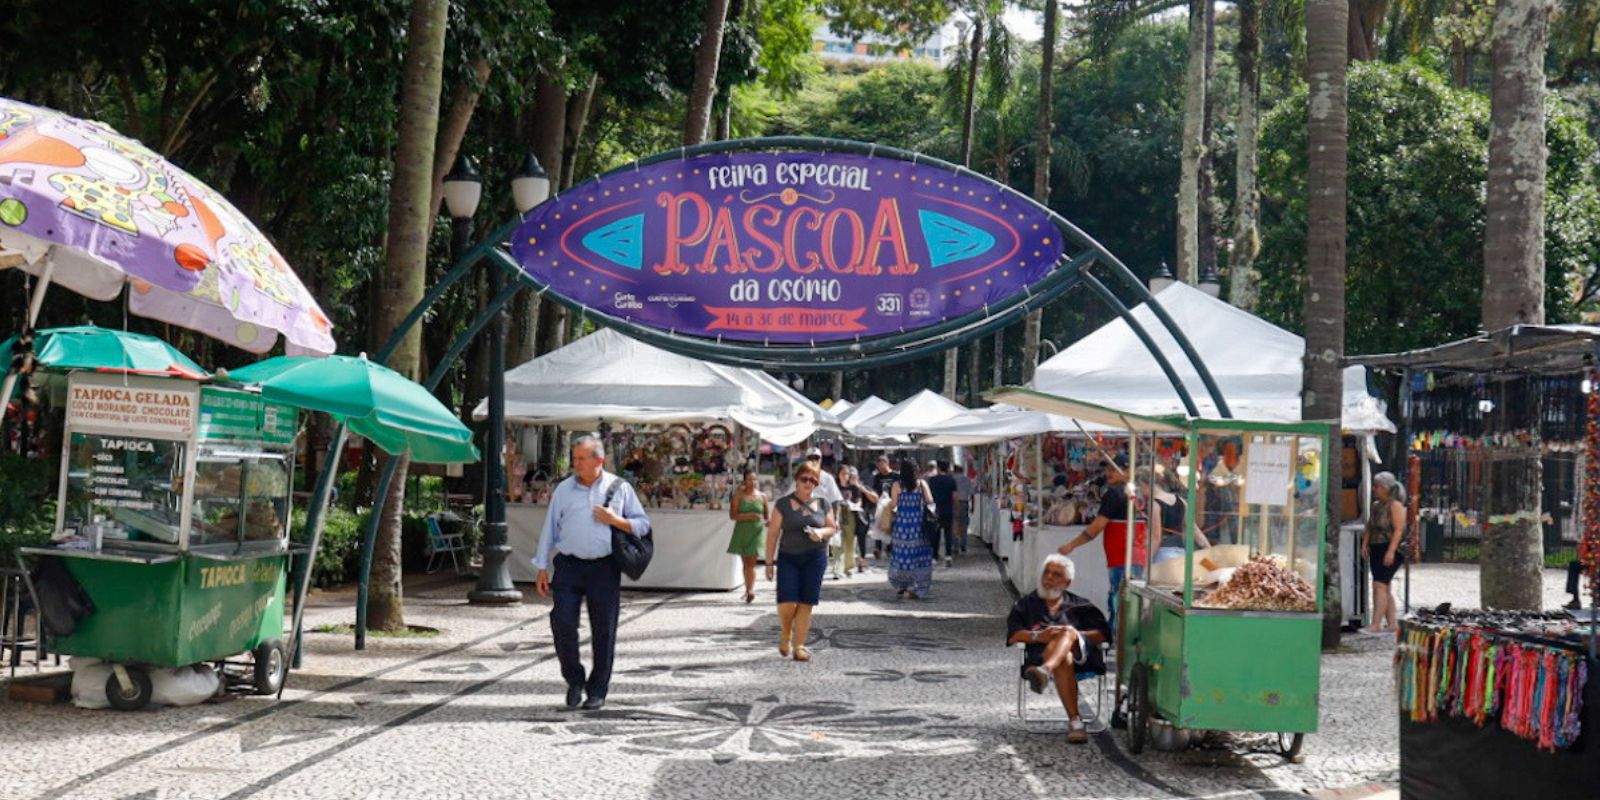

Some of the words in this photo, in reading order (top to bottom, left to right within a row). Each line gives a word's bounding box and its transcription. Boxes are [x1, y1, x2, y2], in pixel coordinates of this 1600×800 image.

[708, 163, 768, 190] feira
[776, 162, 872, 191] especial
[653, 191, 919, 276] PÁSCOA
[730, 278, 760, 302] da
[768, 276, 841, 302] osório
[877, 296, 901, 312] 331
[778, 312, 794, 326] de
[73, 388, 132, 402] TAPIOCA
[135, 391, 191, 406] GELADA
[71, 401, 94, 410] COCO
[96, 403, 137, 414] MORANGO
[142, 406, 191, 418] CHOCOLATE
[100, 438, 155, 453] TAPIOCA
[201, 564, 246, 589] TAPIOCA
